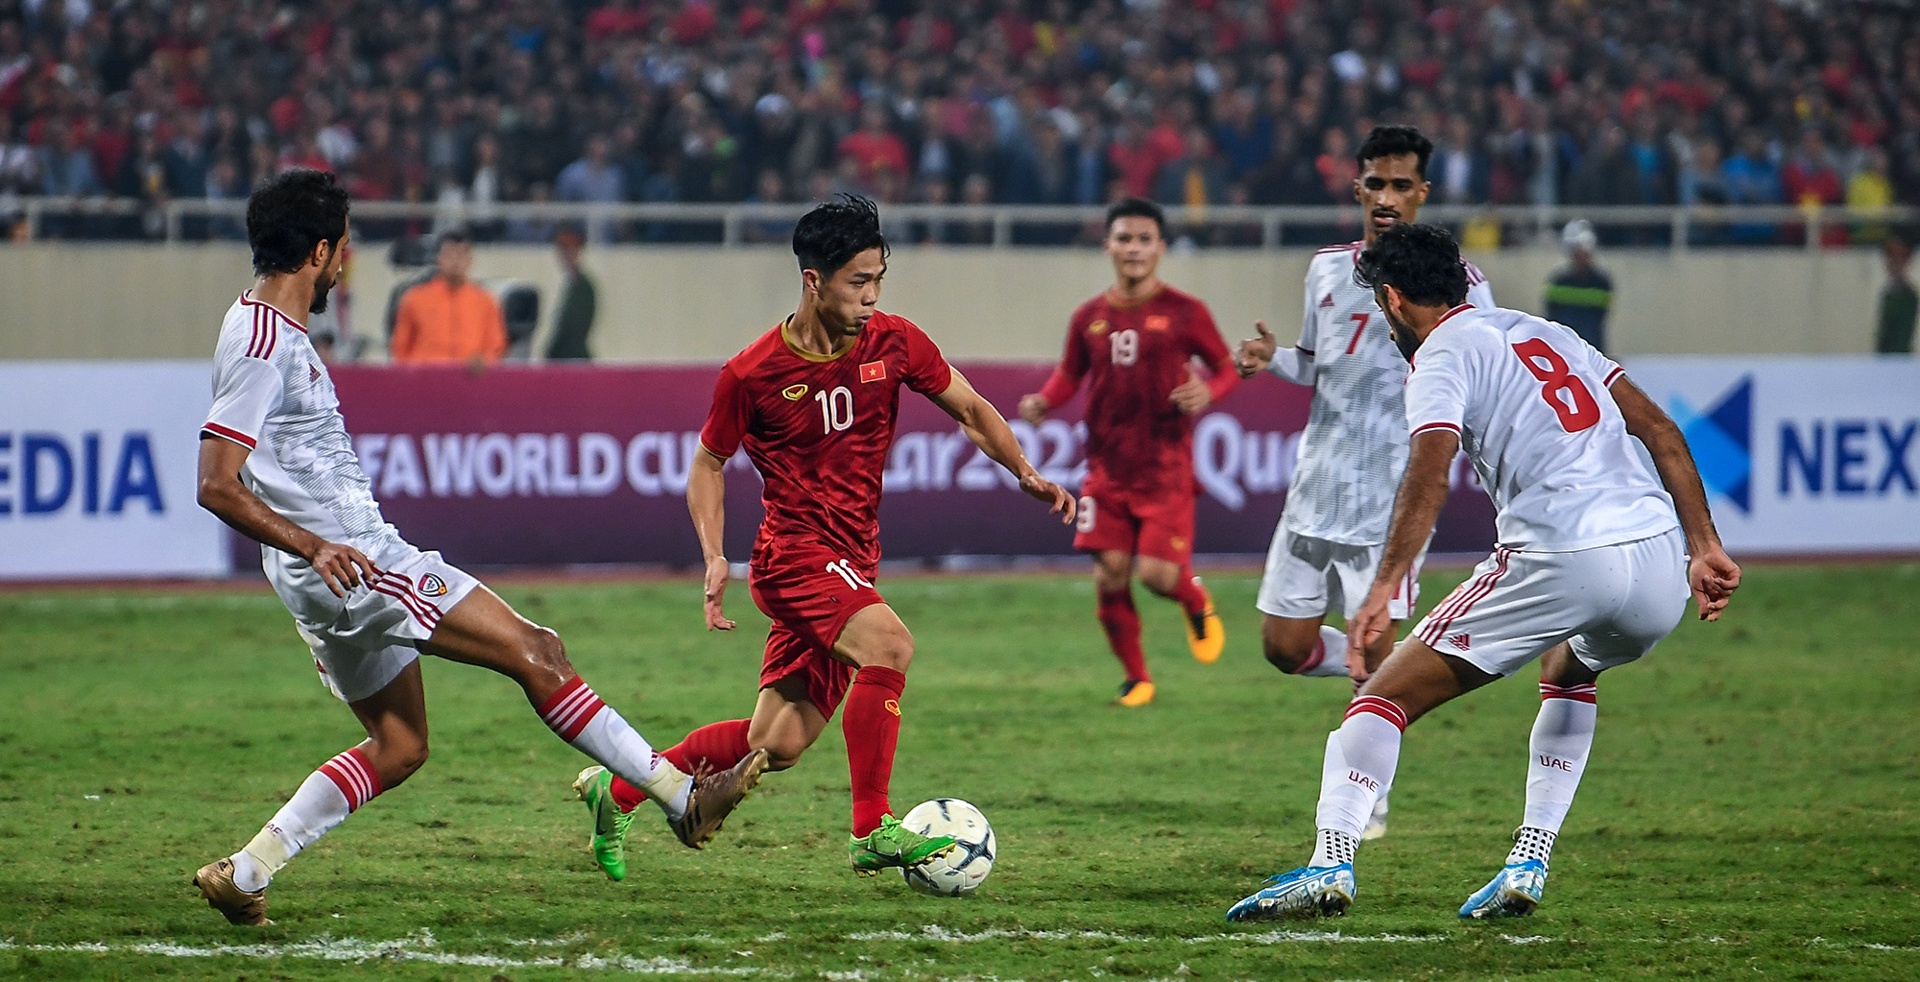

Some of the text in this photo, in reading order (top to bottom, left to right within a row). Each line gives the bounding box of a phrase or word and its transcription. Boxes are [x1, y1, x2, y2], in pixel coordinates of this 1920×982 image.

[1109, 328, 1139, 366] 19
[1346, 313, 1370, 355] 7
[1511, 337, 1601, 433] 8
[815, 386, 854, 435] 10
[421, 431, 622, 498] WORLD
[626, 430, 750, 497] CU
[1777, 418, 1918, 497] NEX
[1348, 770, 1379, 793] UAE
[1539, 754, 1573, 773] UAE
